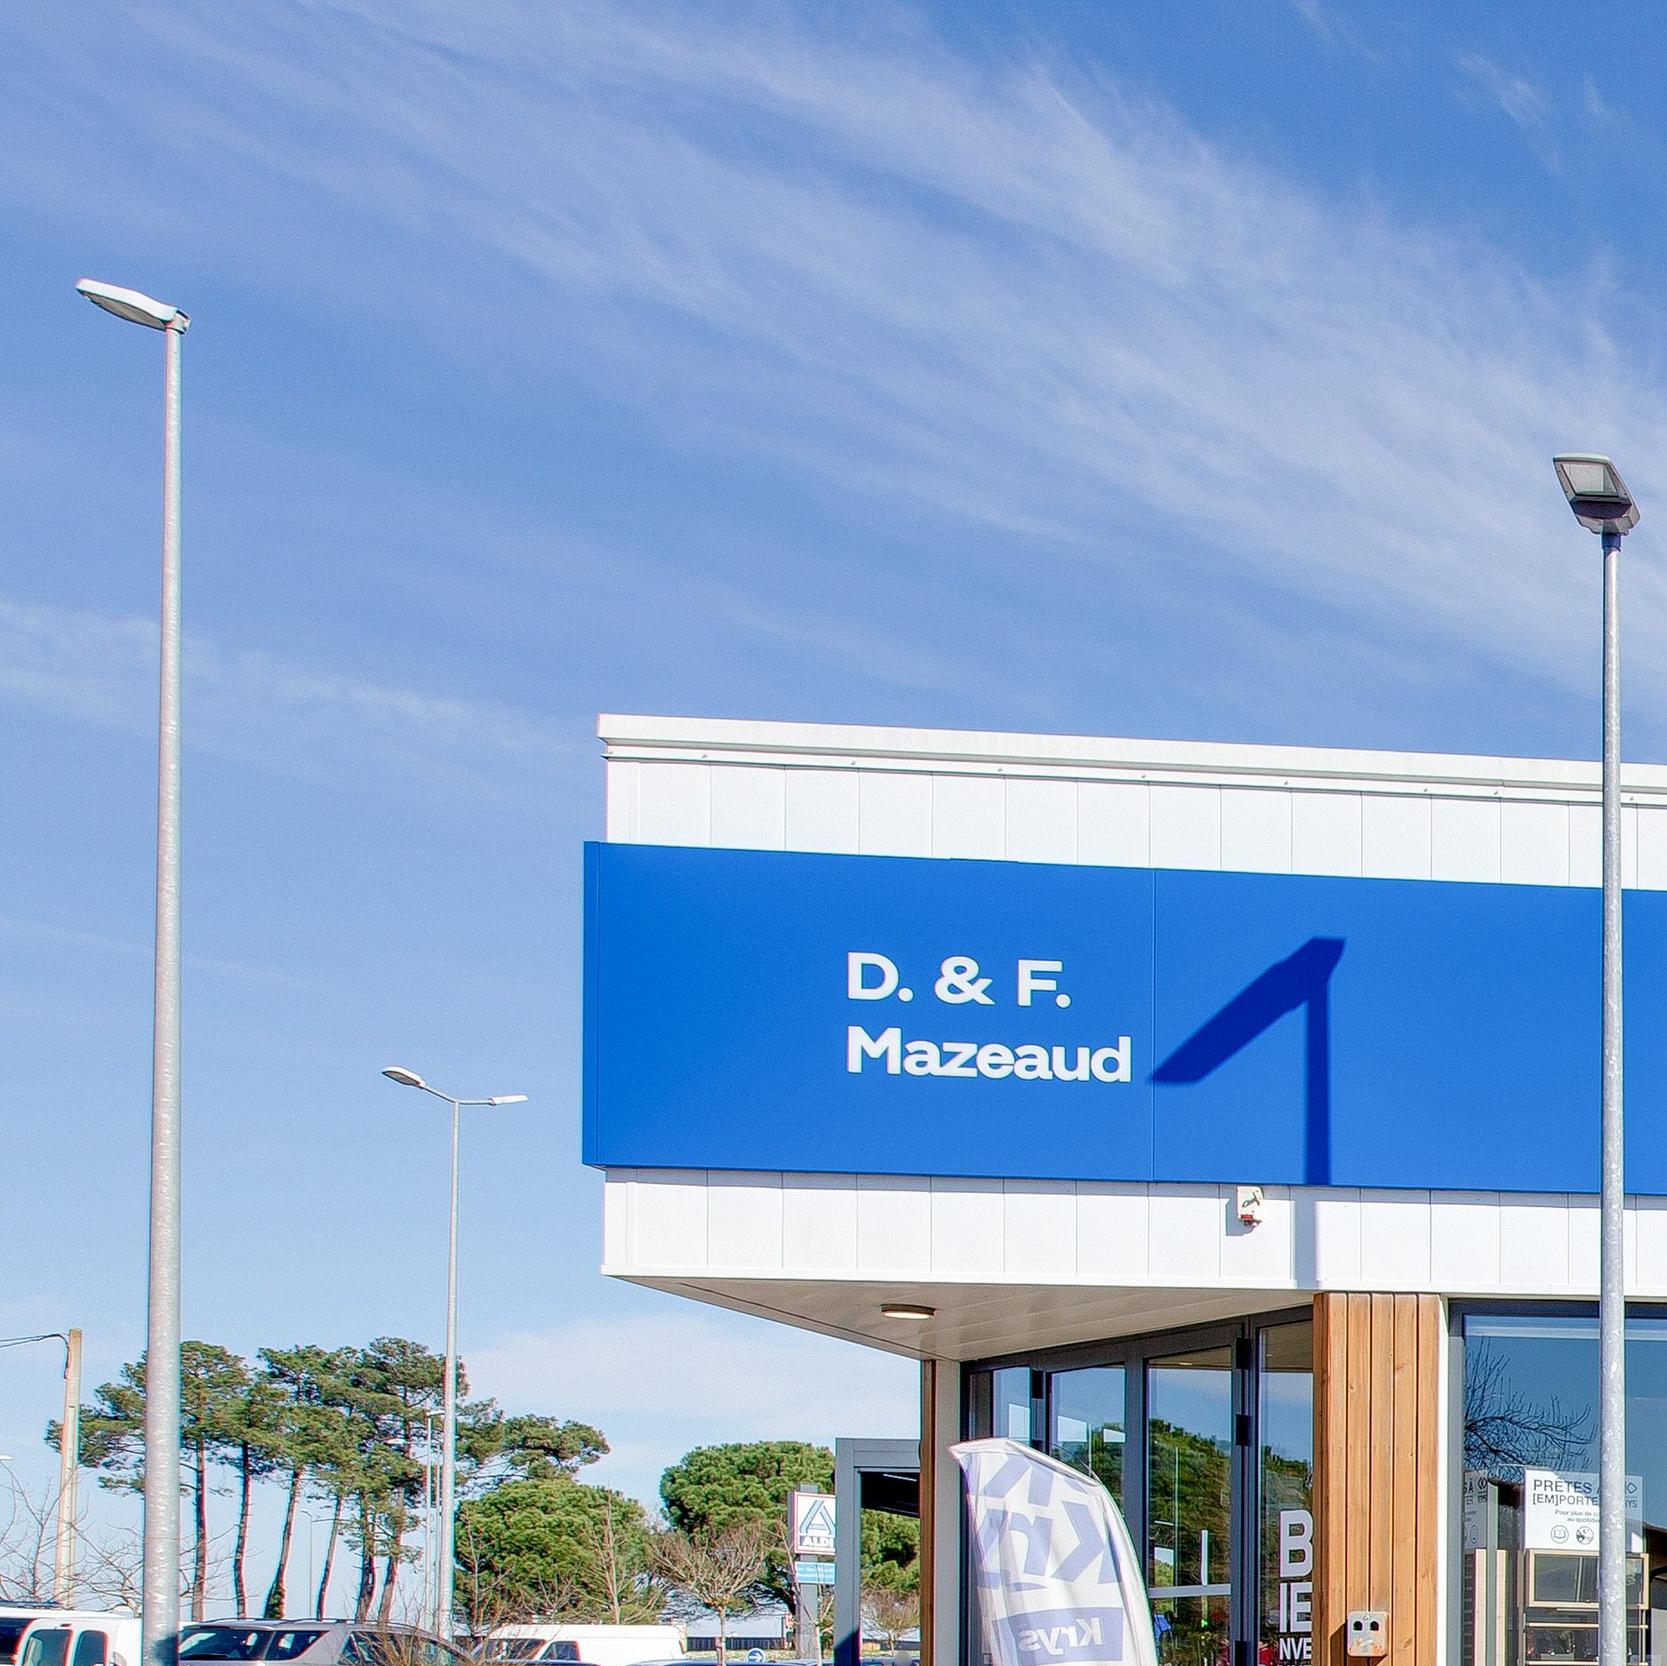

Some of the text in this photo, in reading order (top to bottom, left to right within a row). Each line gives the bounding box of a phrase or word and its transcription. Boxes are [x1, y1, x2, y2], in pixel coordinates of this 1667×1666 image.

[847, 951, 1072, 1008] D. & F.
[846, 1026, 1133, 1083] Mazeaud
[1532, 1493, 1600, 1506] [EM]PORTE
[1279, 1509, 1314, 1578] B
[1279, 1581, 1313, 1634] IE
[1279, 1637, 1312, 1661] NVE
